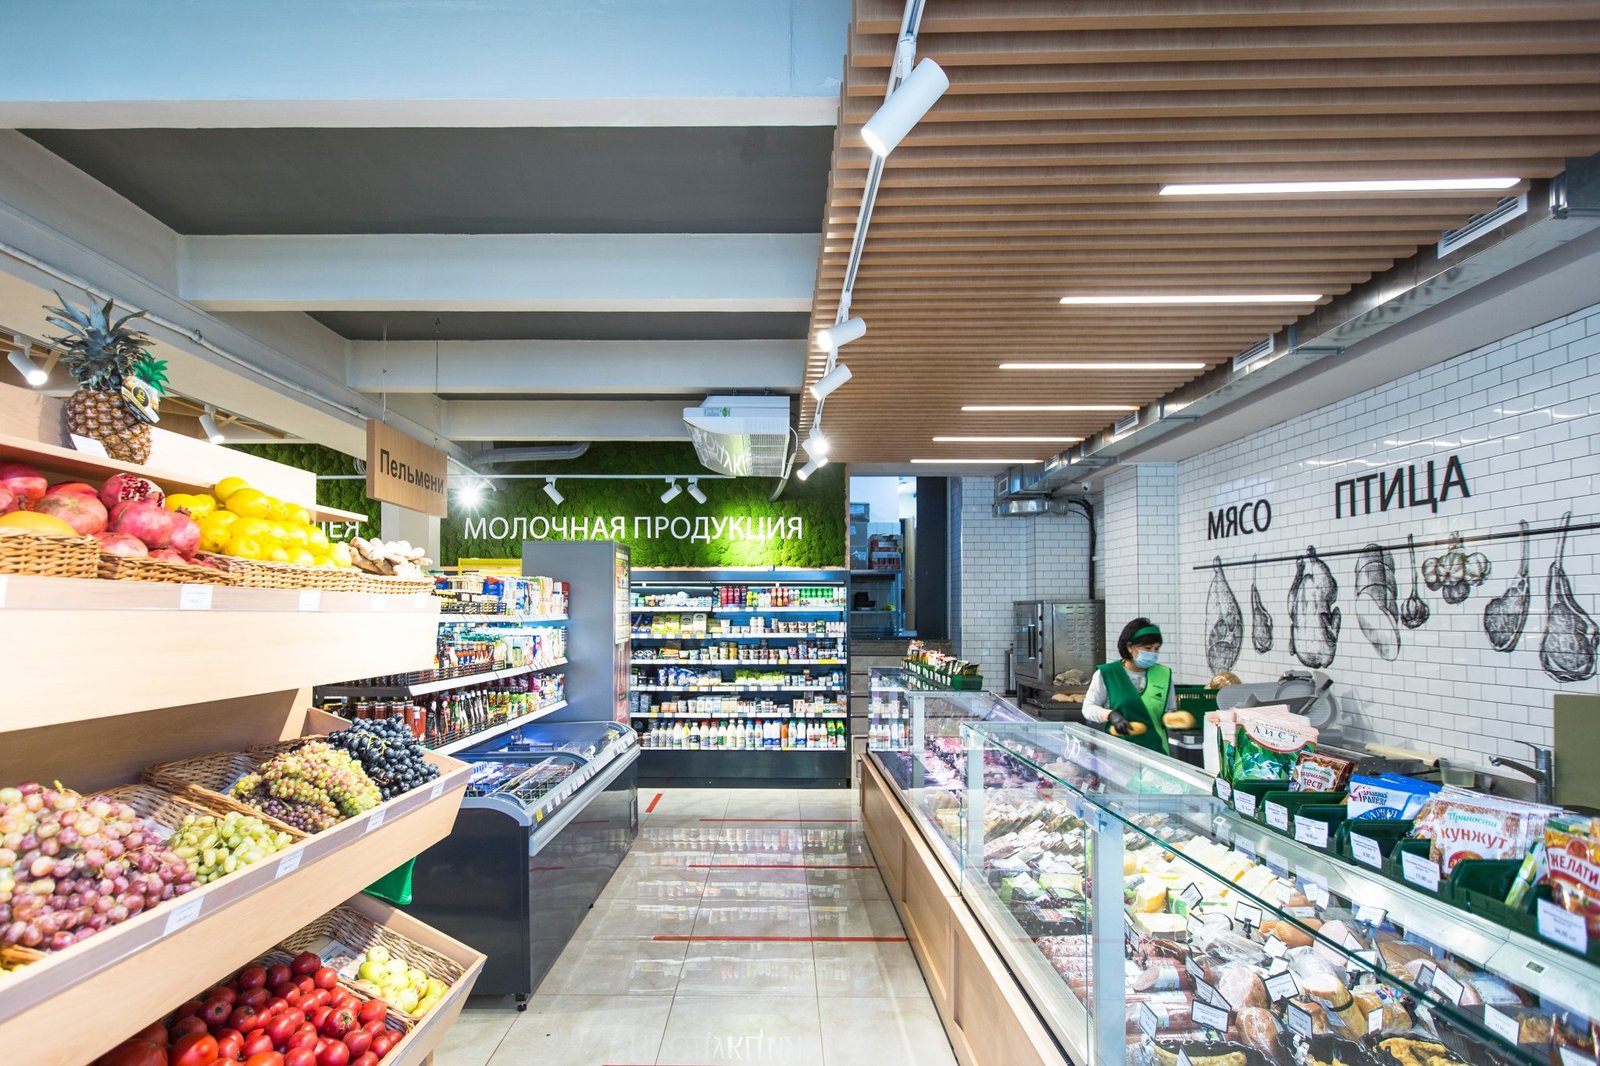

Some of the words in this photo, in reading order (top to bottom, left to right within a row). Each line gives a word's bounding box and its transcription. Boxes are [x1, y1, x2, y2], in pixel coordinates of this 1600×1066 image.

[380, 448, 444, 495] Пельмени
[1335, 454, 1471, 519] ПТИЦА
[464, 515, 626, 540] МОЛОЧНАЯ
[634, 515, 803, 544] ПРОДУКЦИЯ
[1207, 498, 1272, 541] МЯСО
[1550, 853, 1600, 886] ЖЕЛАТИ
